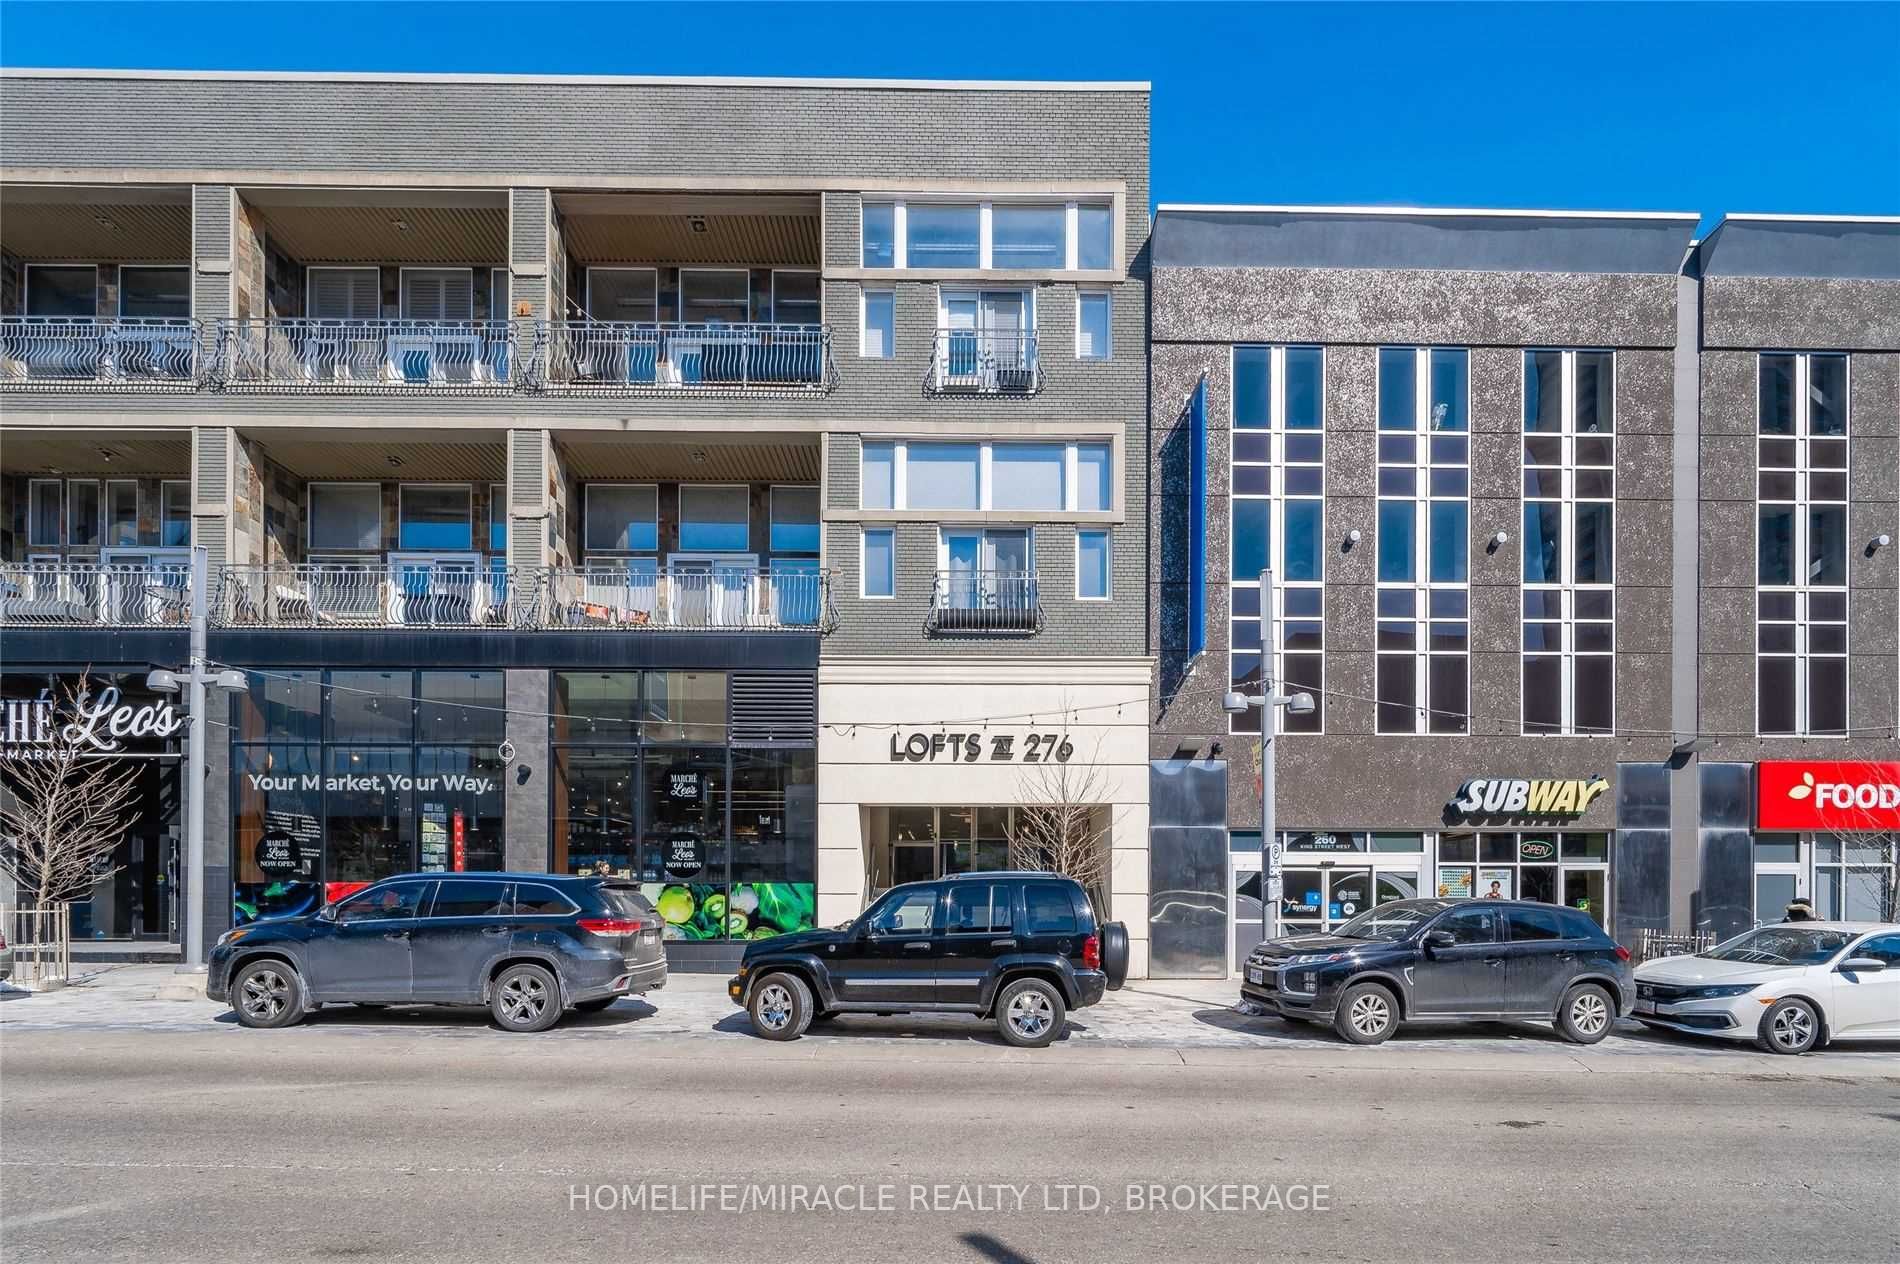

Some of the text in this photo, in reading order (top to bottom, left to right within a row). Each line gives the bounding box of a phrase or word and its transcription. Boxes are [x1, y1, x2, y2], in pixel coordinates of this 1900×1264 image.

[0, 688, 53, 742] HÉ
[62, 686, 181, 750] Leo's
[890, 733, 981, 762] LOFTS
[1023, 733, 1074, 762] 276
[7, 749, 78, 760] MARKET
[248, 774, 296, 791] Your
[387, 774, 438, 791] Your
[670, 772, 698, 783] MARCHÉ
[670, 783, 697, 797] Leo's
[1457, 778, 1610, 813] SUBWAY
[1815, 783, 1900, 809] FOOD
[266, 838, 290, 847] MARCHÉ
[672, 840, 695, 848] MARCHÉ
[1522, 844, 1549, 855] OPEN
[260, 860, 297, 868] NOW OPEN
[666, 861, 702, 869] NOW OPEN
